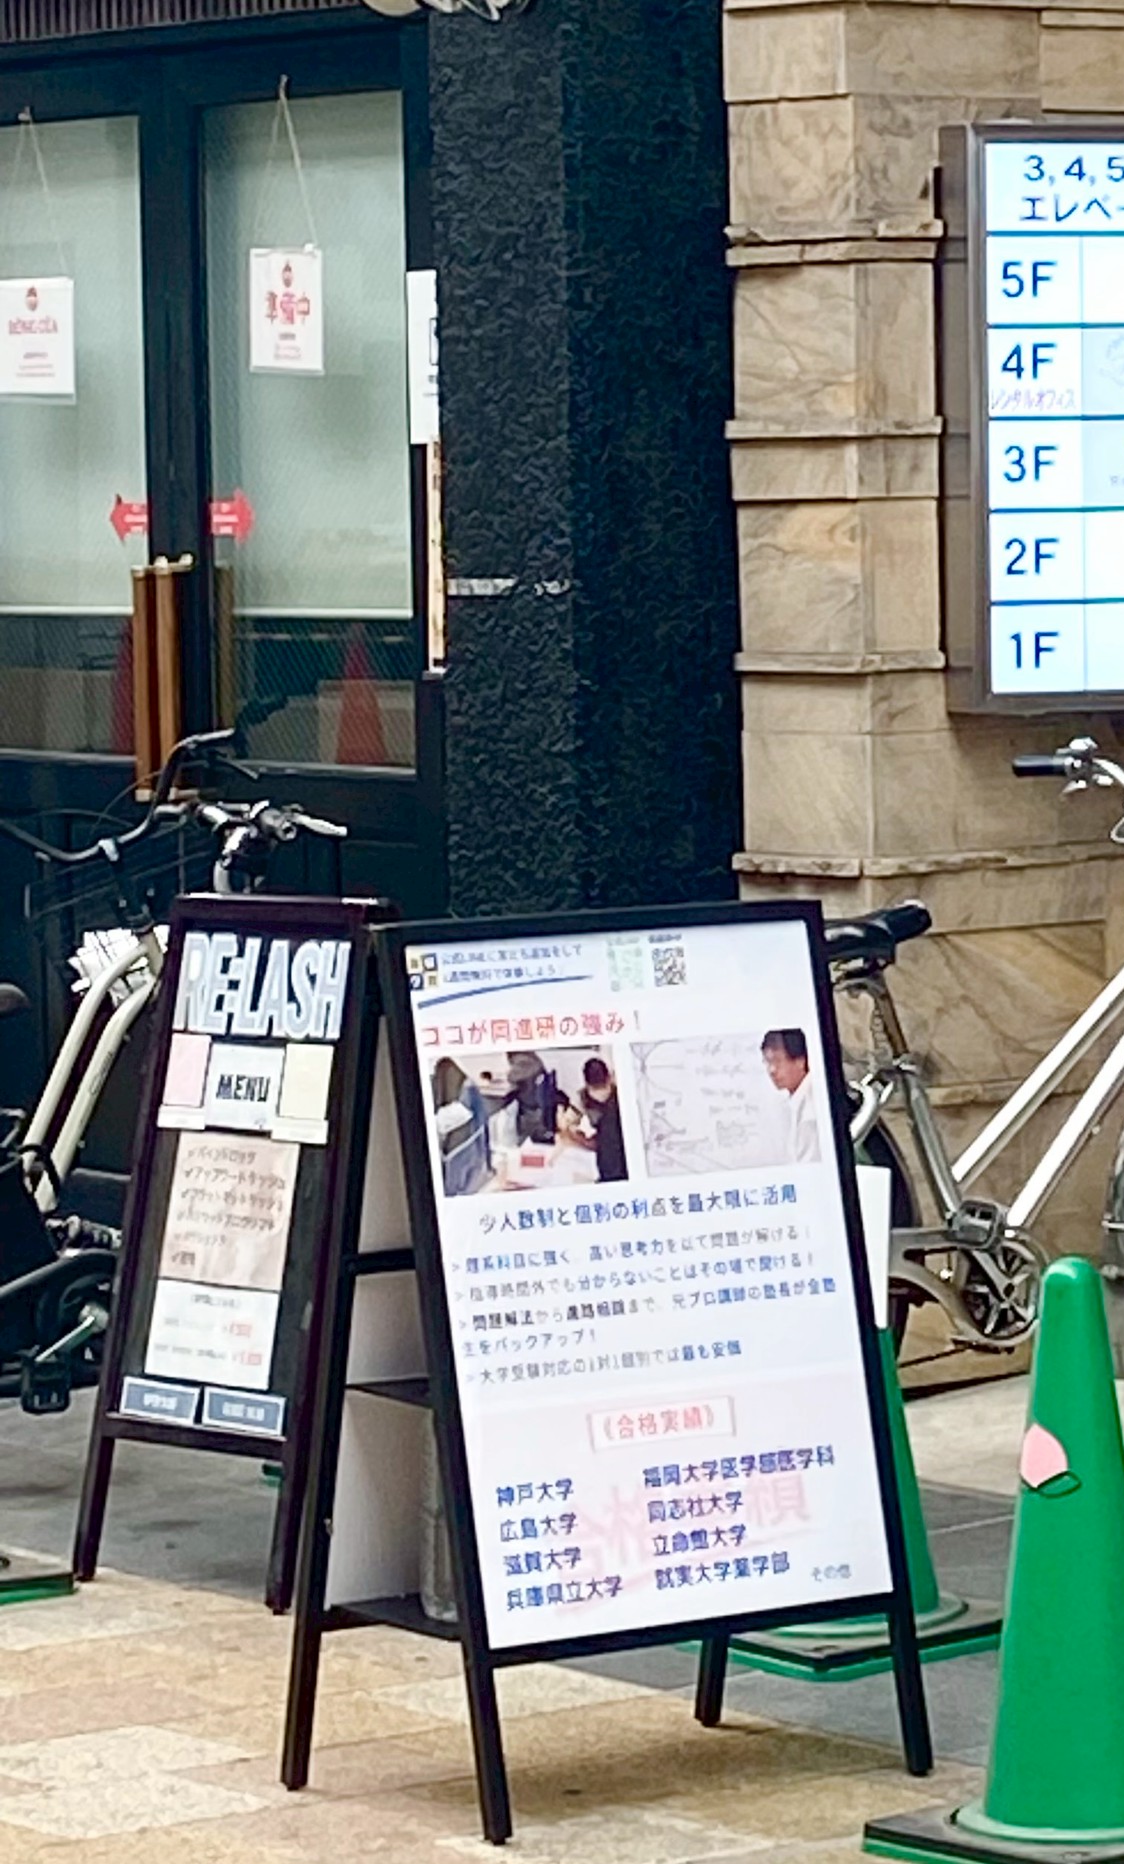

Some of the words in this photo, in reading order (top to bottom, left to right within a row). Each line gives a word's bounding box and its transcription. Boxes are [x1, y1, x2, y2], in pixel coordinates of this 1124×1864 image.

[1001, 260, 1058, 298] 5F
[1001, 342, 1057, 380] 4F
[1003, 444, 1058, 482] 3F
[1004, 536, 1060, 576] 2F
[1009, 630, 1060, 670] 1F
[215, 1073, 271, 1103] MENU
[642, 1444, 836, 1489] 福岡大学医学部医学科
[496, 1477, 574, 1508] 神戸大学
[647, 1490, 744, 1524] 同志社大学
[499, 1511, 578, 1542] 広島大学
[652, 1523, 747, 1557] 立命館大学
[503, 1546, 582, 1577] 滋賀大学
[654, 1550, 791, 1591] 就実大学薬学部
[506, 1574, 624, 1612] 兵庫県立大学
